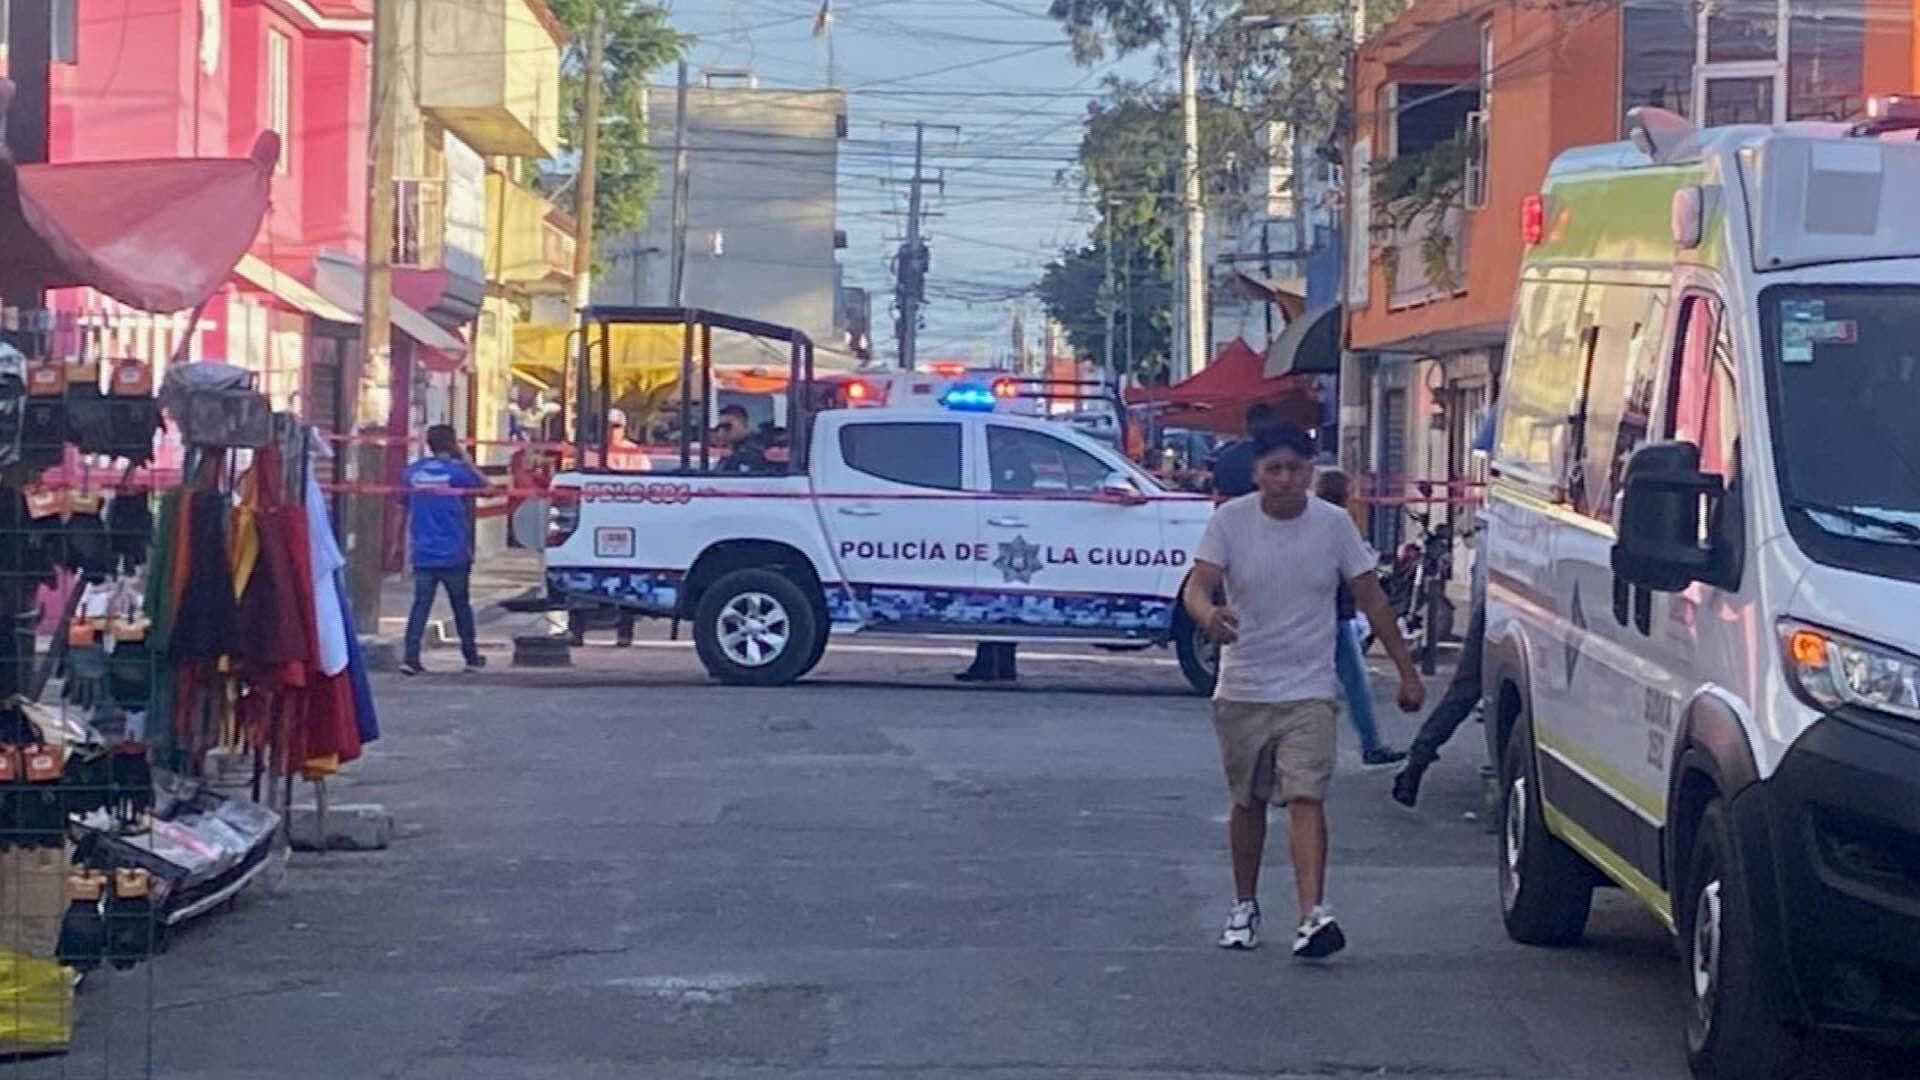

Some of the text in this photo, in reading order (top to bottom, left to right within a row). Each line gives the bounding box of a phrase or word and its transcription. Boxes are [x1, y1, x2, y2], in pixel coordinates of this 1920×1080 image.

[839, 538, 1187, 567] POLICÍA DE LA CIUDAD
